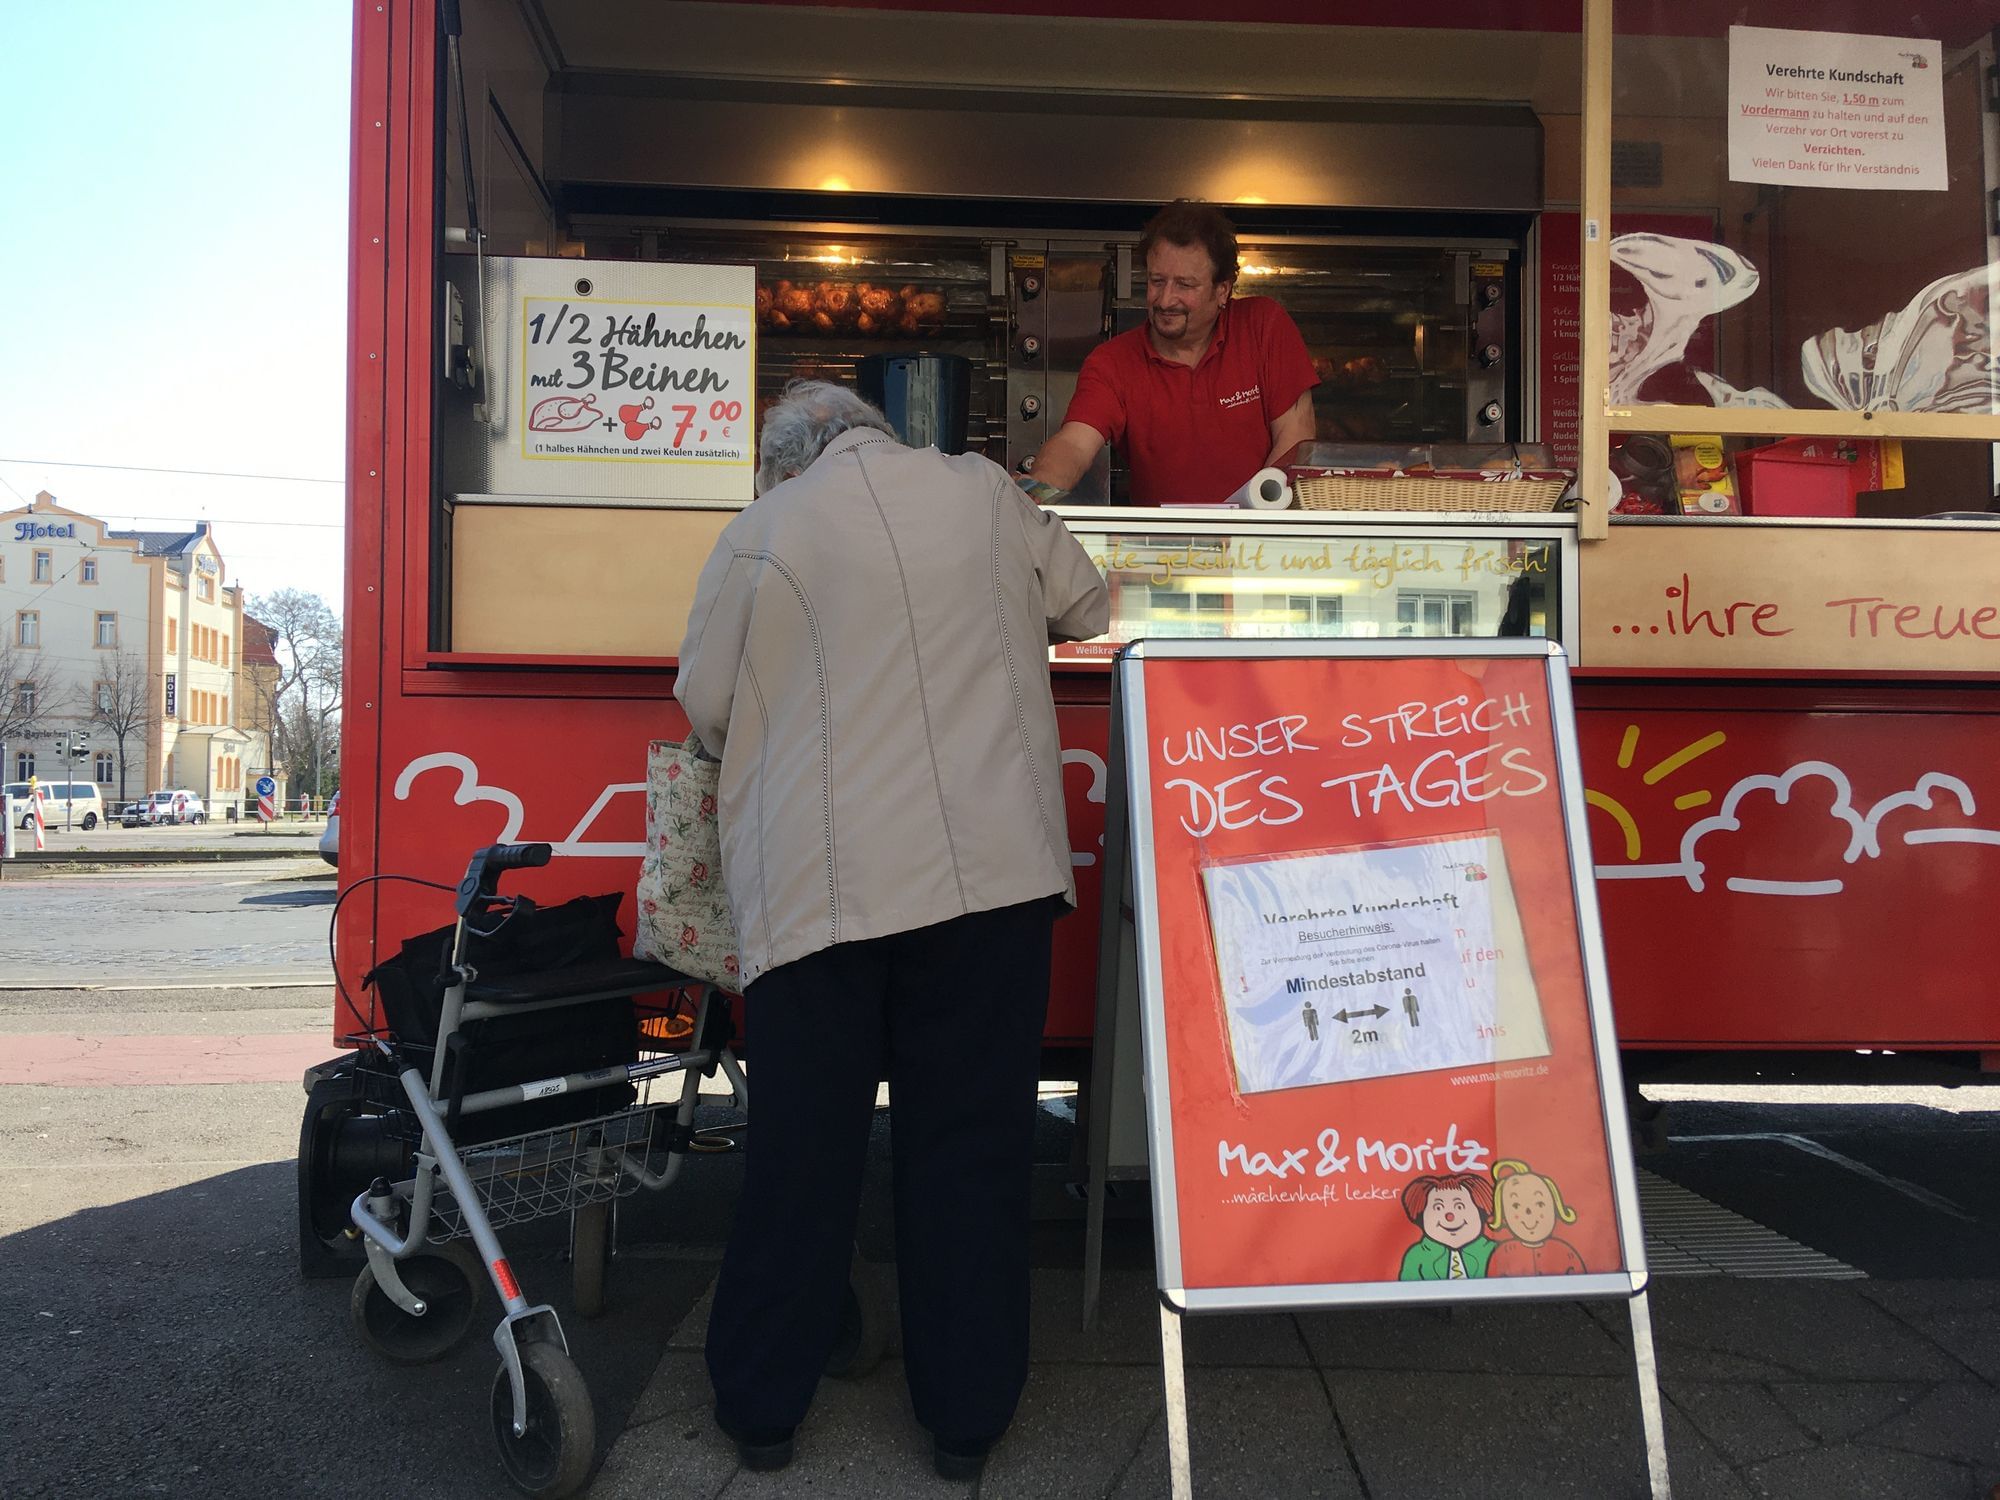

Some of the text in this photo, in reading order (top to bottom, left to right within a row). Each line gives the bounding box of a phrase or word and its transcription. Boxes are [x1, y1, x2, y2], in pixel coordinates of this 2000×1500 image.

[1766, 64, 1904, 85] Verehrte Kundschaft
[1765, 88, 1904, 106] Wir bitten Sie, 1,50 m zum
[1741, 103, 1928, 125] Vordermann zu halten und auf den
[1766, 123, 1904, 141] Verzehr vor Ort vorerst zu
[1803, 143, 1865, 156] Verzichten.
[1752, 157, 1920, 175] Vielen Dank für Ihr Verständnis
[529, 304, 746, 350] 1/2 Hähnchen
[530, 346, 729, 393] mit 3 Beinen
[535, 444, 740, 459] (1 halbes Hähnchen und zwei Keulen zusätzlich)
[1553, 443, 1577, 451] Gurke
[14, 522, 75, 541] Hotel
[1151, 541, 1271, 586] gekühlt
[1281, 544, 1333, 572] und
[1344, 543, 1442, 589] täglich
[1455, 543, 1550, 581] frisch!
[1825, 597, 2000, 639] Treue
[166, 674, 175, 716] HOTEL
[1162, 714, 1319, 766] UNSER
[1164, 742, 1548, 838] DES TAGES
[1298, 920, 1395, 942] Besucherhinweis:
[1475, 948, 1504, 961] den
[1286, 963, 1426, 994] Mindestabstand
[1351, 1028, 1379, 1044] 2m
[1450, 1063, 1549, 1087] www.max-moritz.de
[1345, 1182, 1401, 1201] lecker
